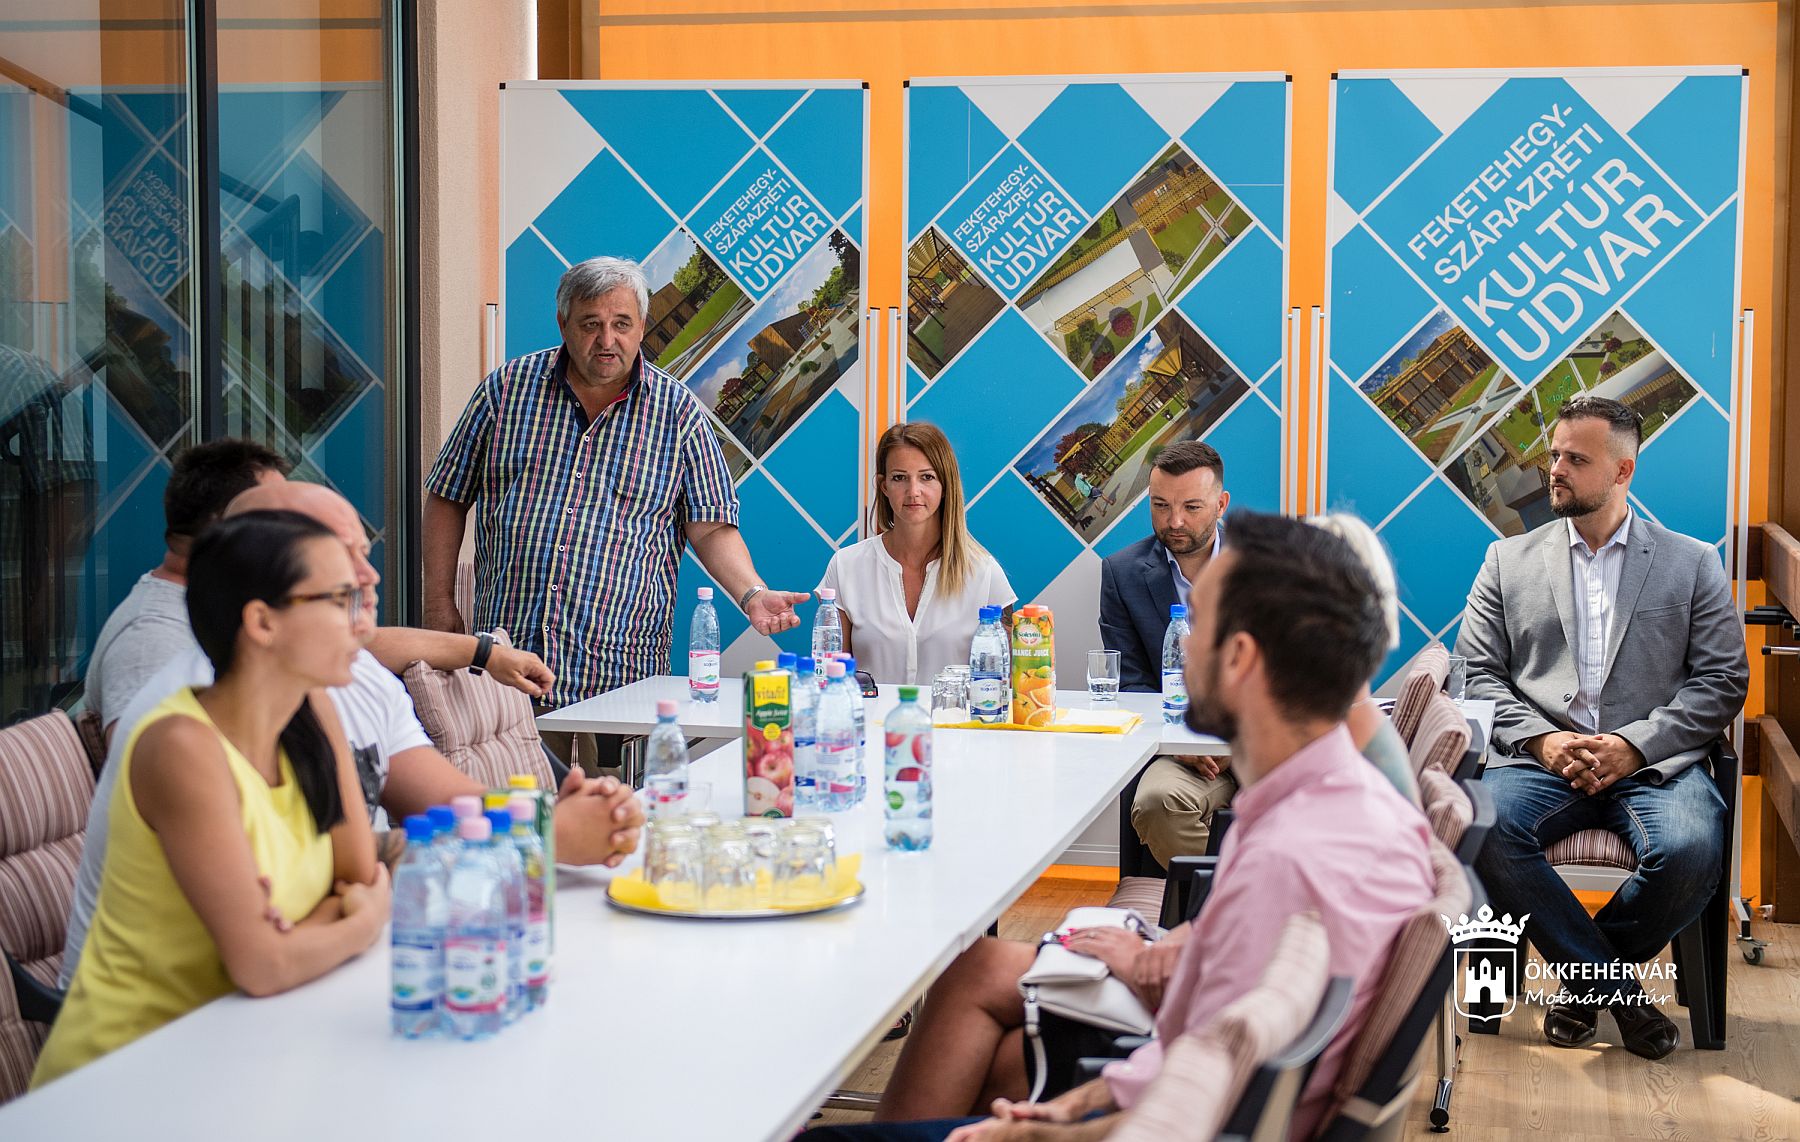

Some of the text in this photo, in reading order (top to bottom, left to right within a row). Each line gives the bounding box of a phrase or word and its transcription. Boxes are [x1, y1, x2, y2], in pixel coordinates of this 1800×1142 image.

[703, 168, 777, 243] FEKETEHEGY-
[715, 178, 791, 255] SZÁRAZRÉTI
[953, 164, 1029, 242] FEKETEHEGY-
[966, 174, 1044, 253] SZÁRAZRÉTI
[1407, 103, 1573, 261] FEKETEHEGY-
[1434, 123, 1604, 284] SZÁRAZRÉTI
[728, 194, 809, 275] KULTÚR
[744, 211, 827, 292] UDVAR
[979, 191, 1063, 274] KULTÚR
[995, 208, 1081, 291] UDVAR
[1462, 158, 1645, 328] KULTÚR
[1496, 194, 1686, 361] UDVAR
